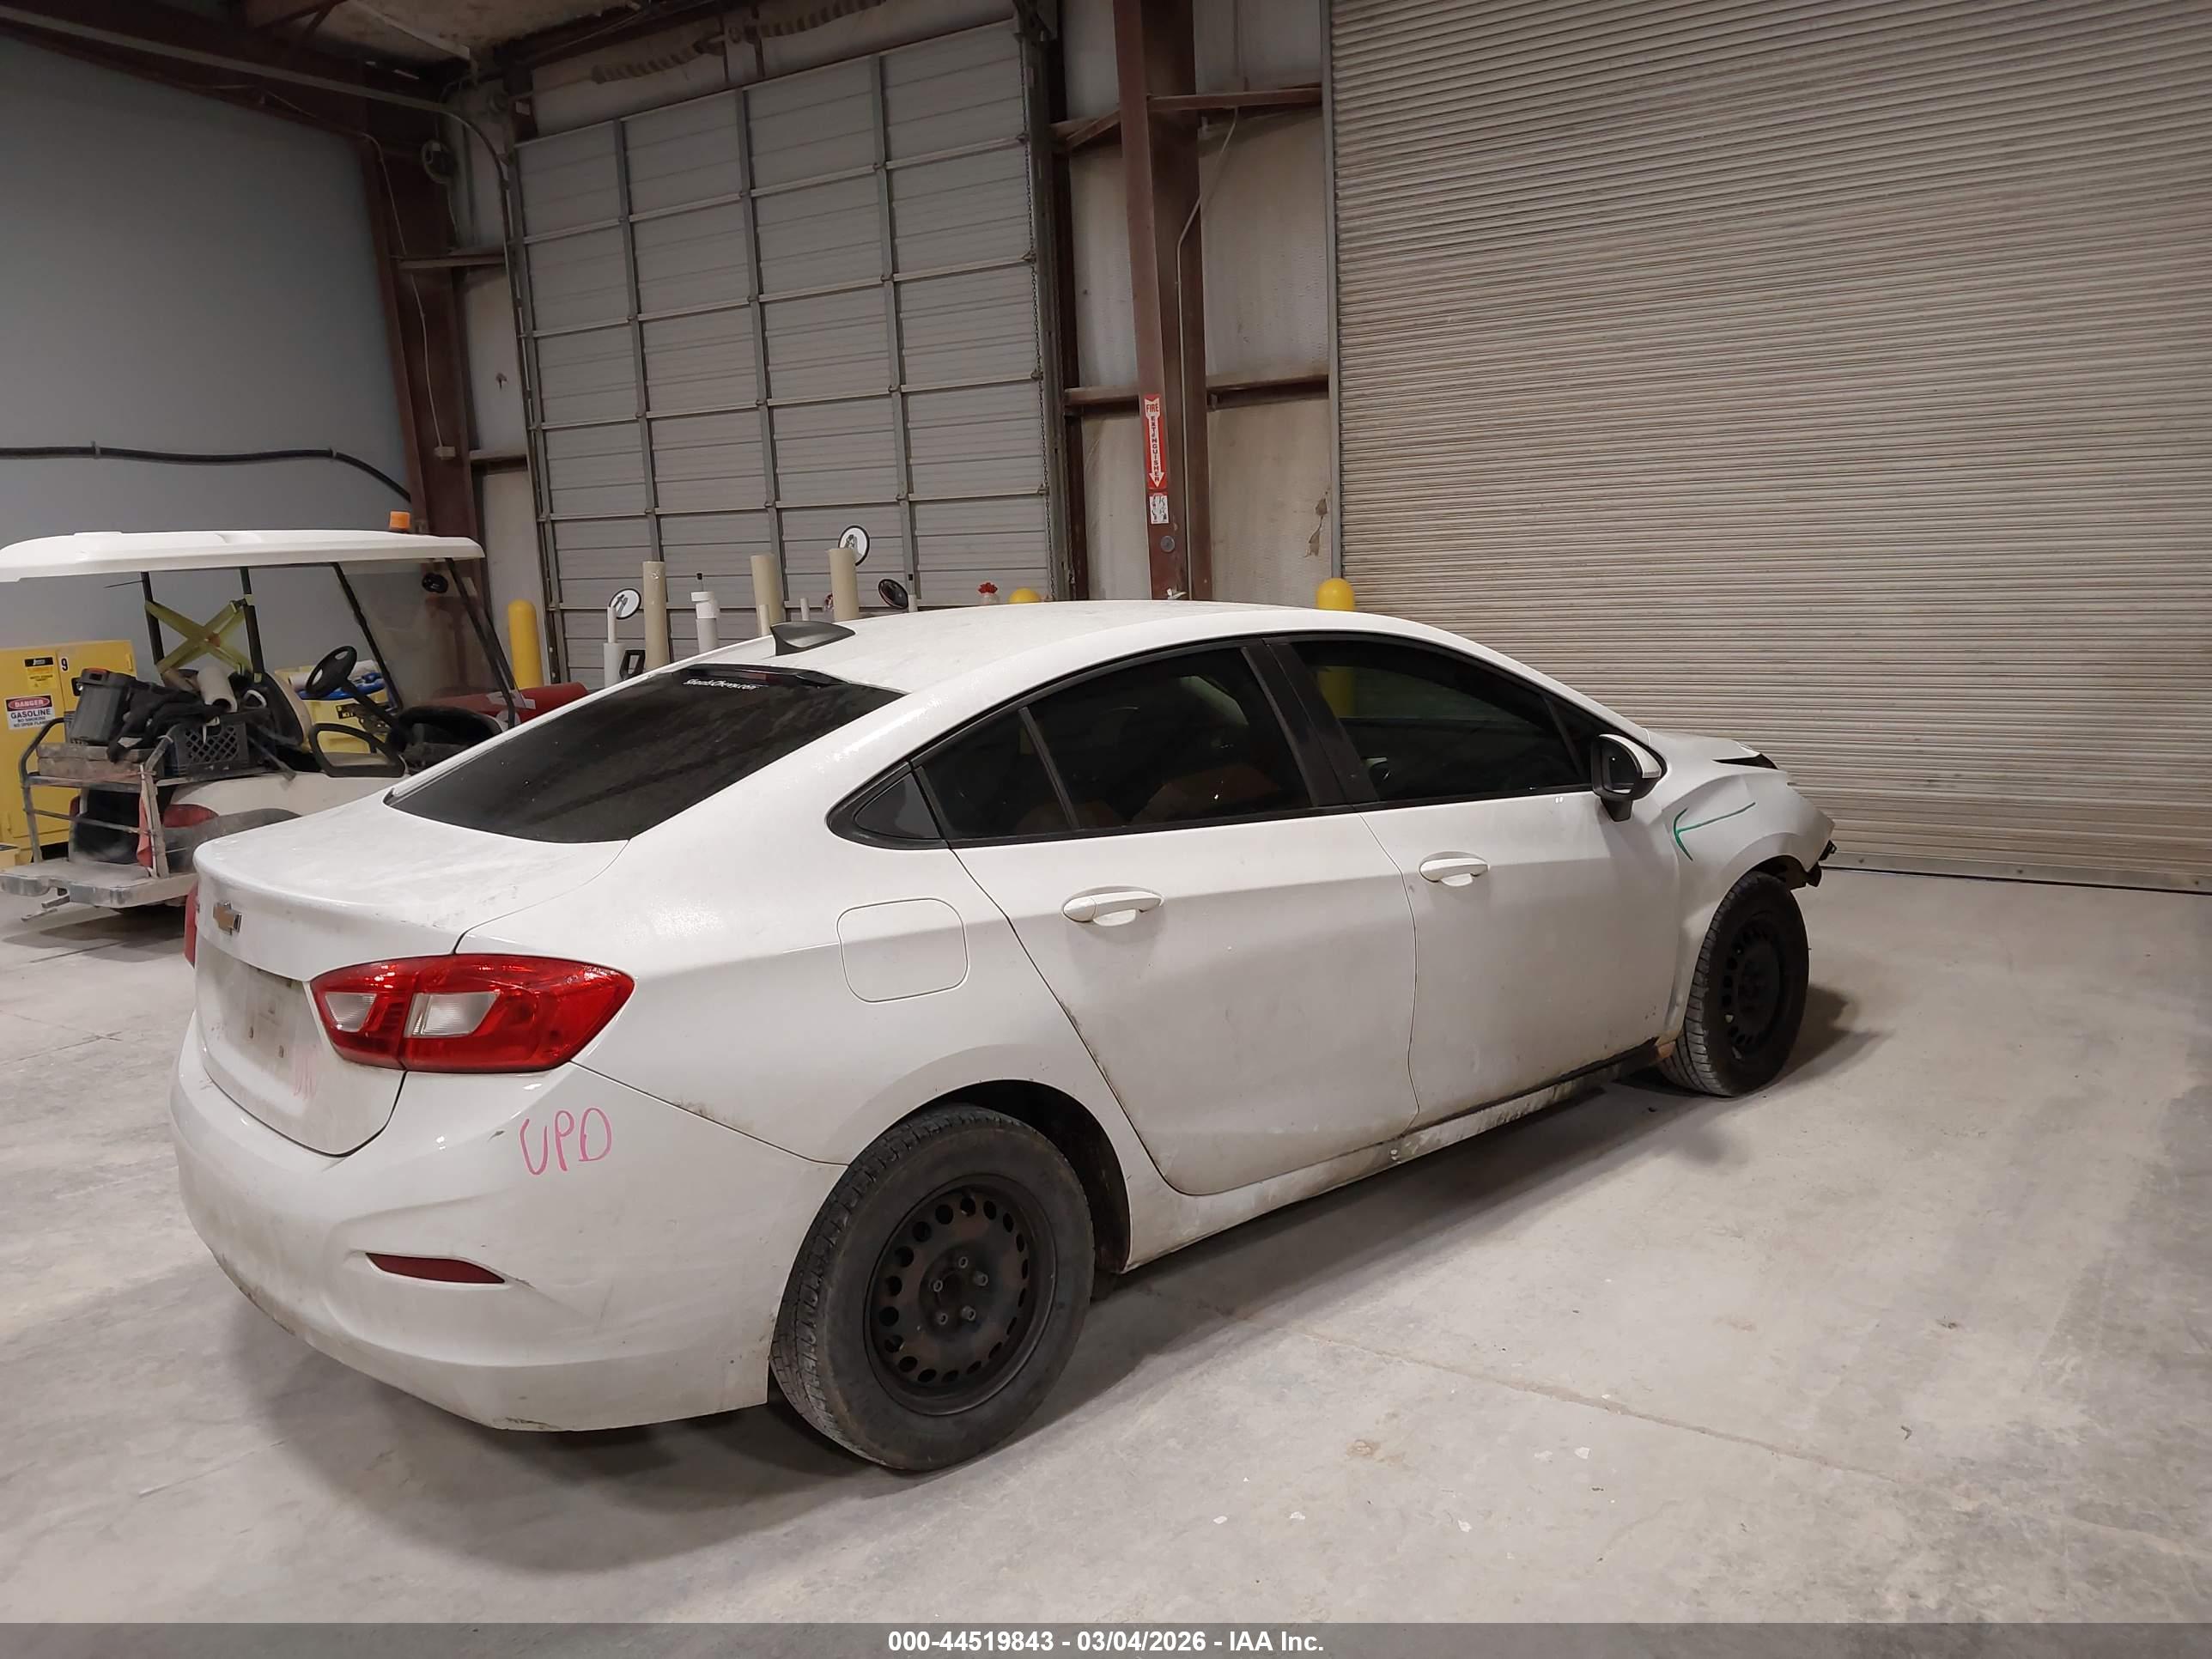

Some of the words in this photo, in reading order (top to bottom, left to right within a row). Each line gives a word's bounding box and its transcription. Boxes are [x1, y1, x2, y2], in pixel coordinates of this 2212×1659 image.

[1146, 403, 1159, 413] FIRE
[1151, 416, 1160, 482] EXTINGUISHER
[61, 658, 68, 671] 9
[10, 708, 52, 719] GASOLINE
[519, 1107, 612, 1176] UPD
